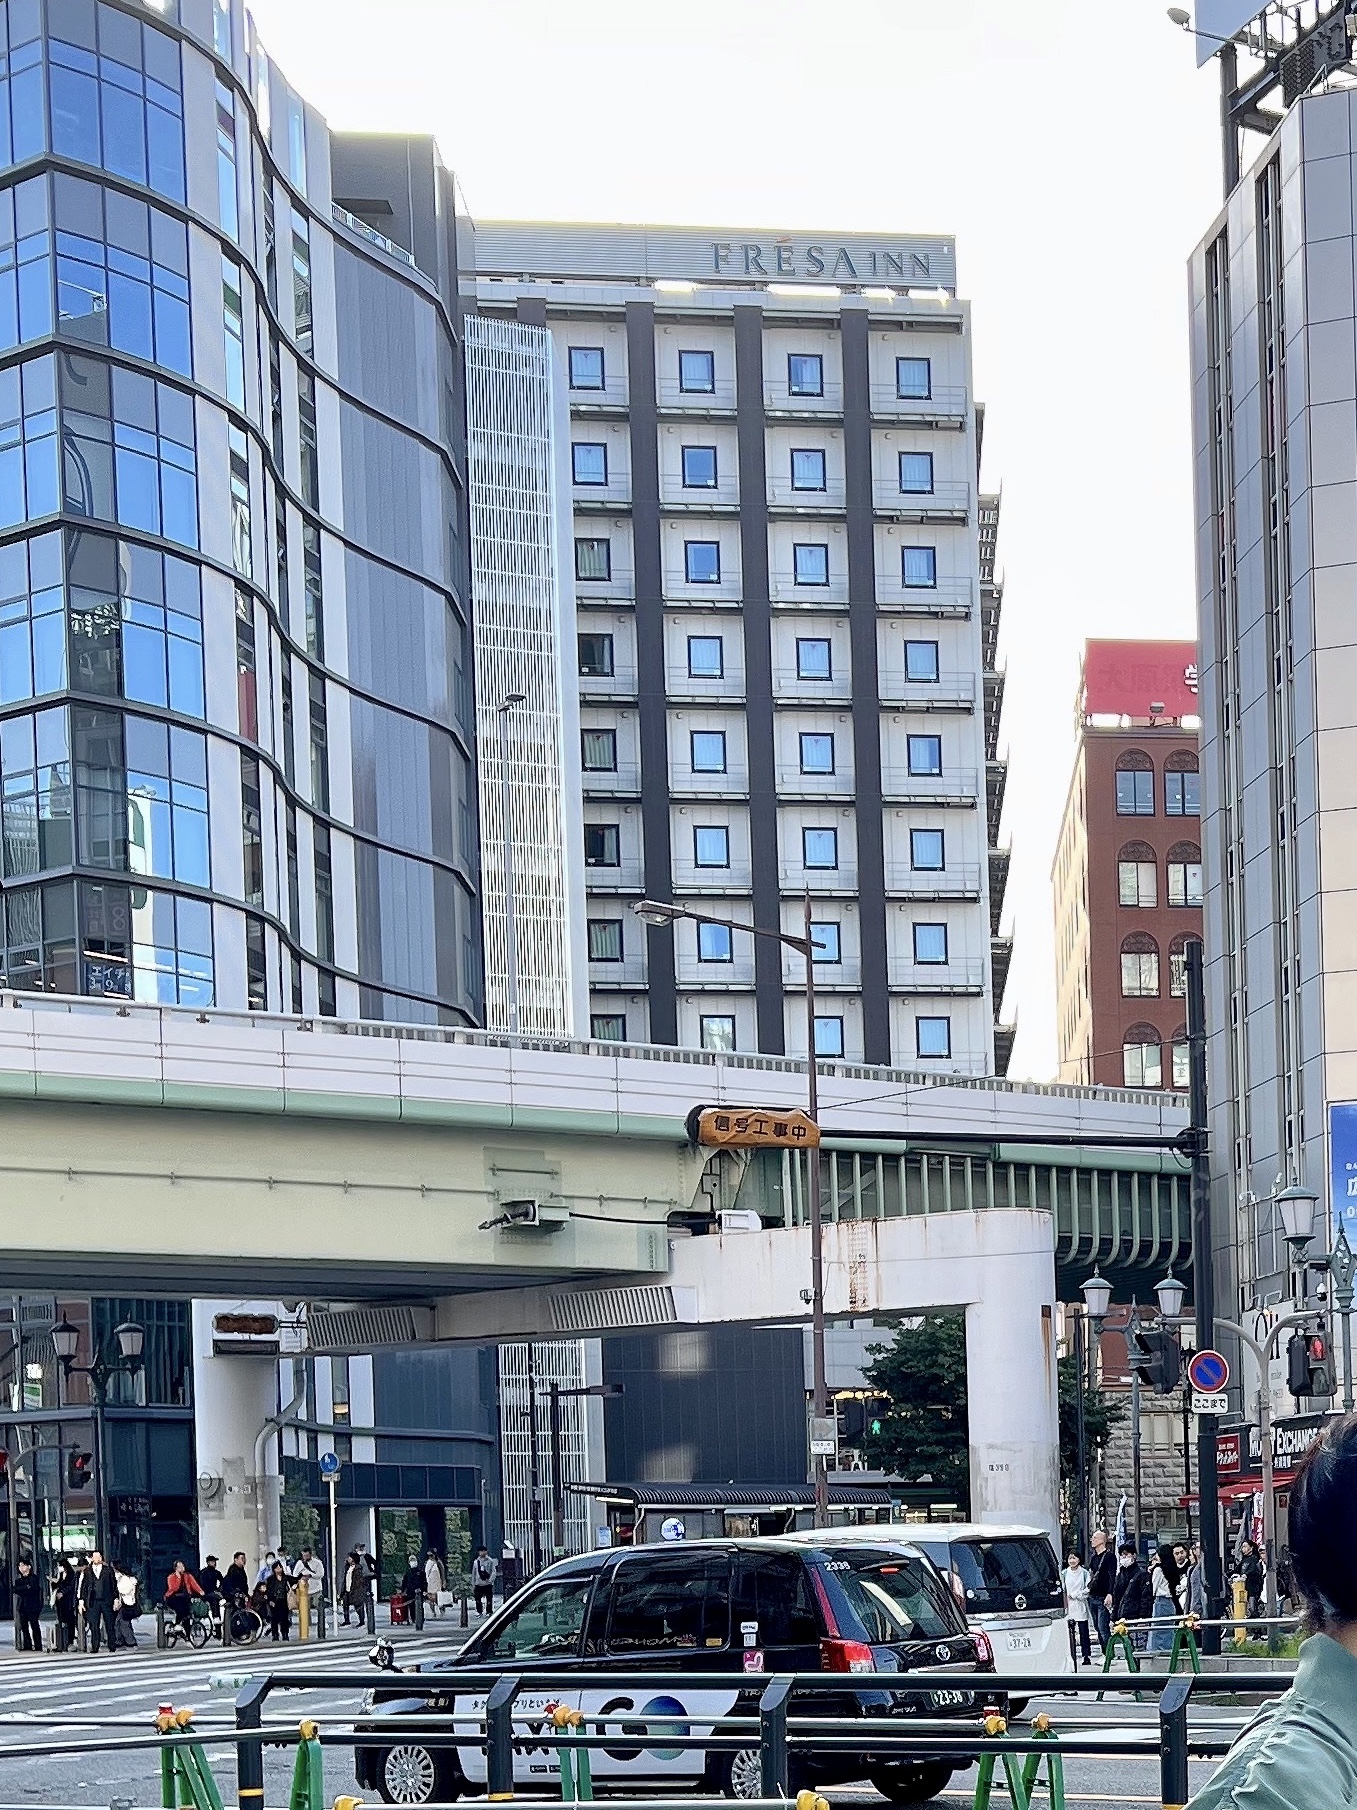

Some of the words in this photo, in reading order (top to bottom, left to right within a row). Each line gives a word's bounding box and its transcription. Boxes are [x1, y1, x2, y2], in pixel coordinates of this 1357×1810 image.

[870, 251, 931, 278] INN
[714, 1115, 807, 1140] 信号工事中
[1193, 1399, 1226, 1409] ここまで
